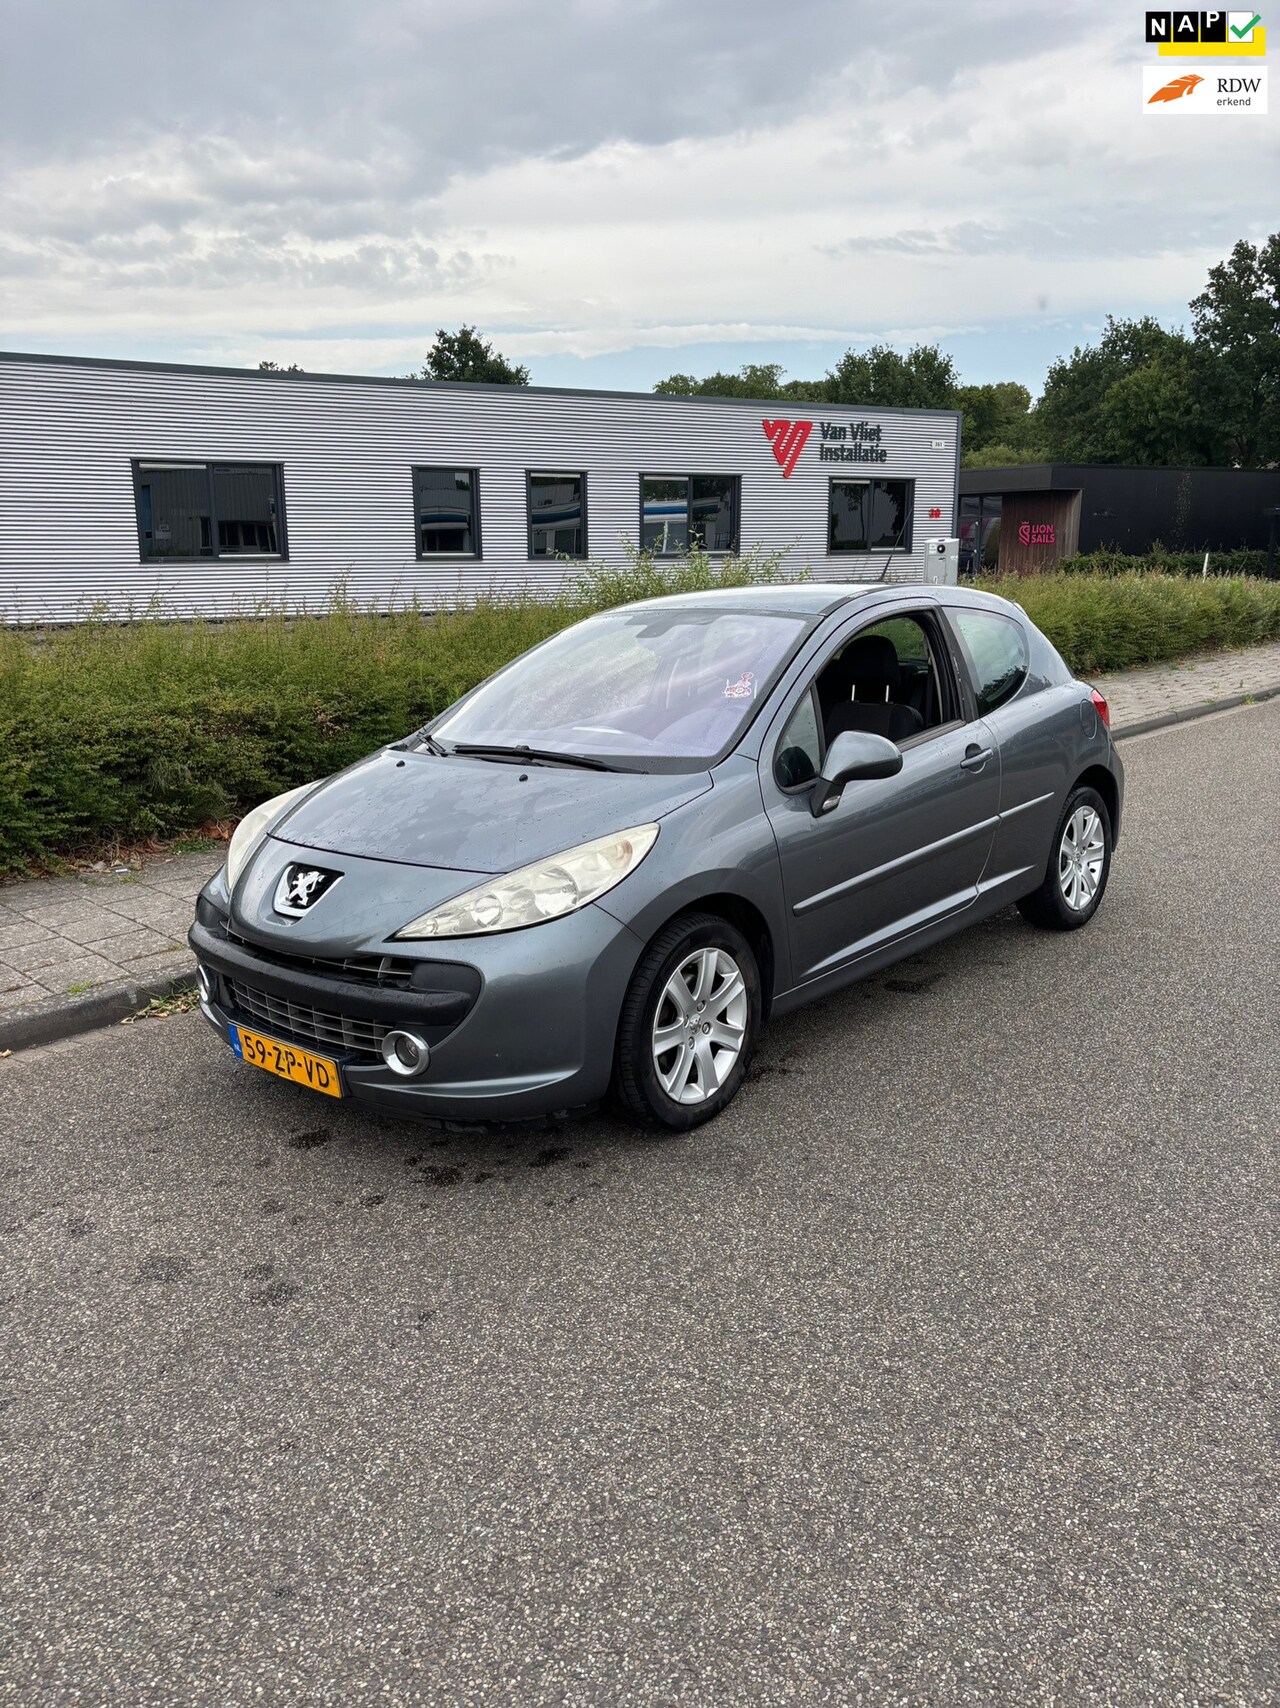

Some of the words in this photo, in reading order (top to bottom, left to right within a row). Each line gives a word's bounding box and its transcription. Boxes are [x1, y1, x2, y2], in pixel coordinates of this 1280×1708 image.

[820, 422, 846, 439] Van
[850, 421, 882, 441] Vliet
[820, 443, 887, 462] Installatie
[1031, 524, 1055, 533] LION
[1031, 534, 1056, 543] SAILS
[244, 1035, 329, 1088] 59-ZP-VD
